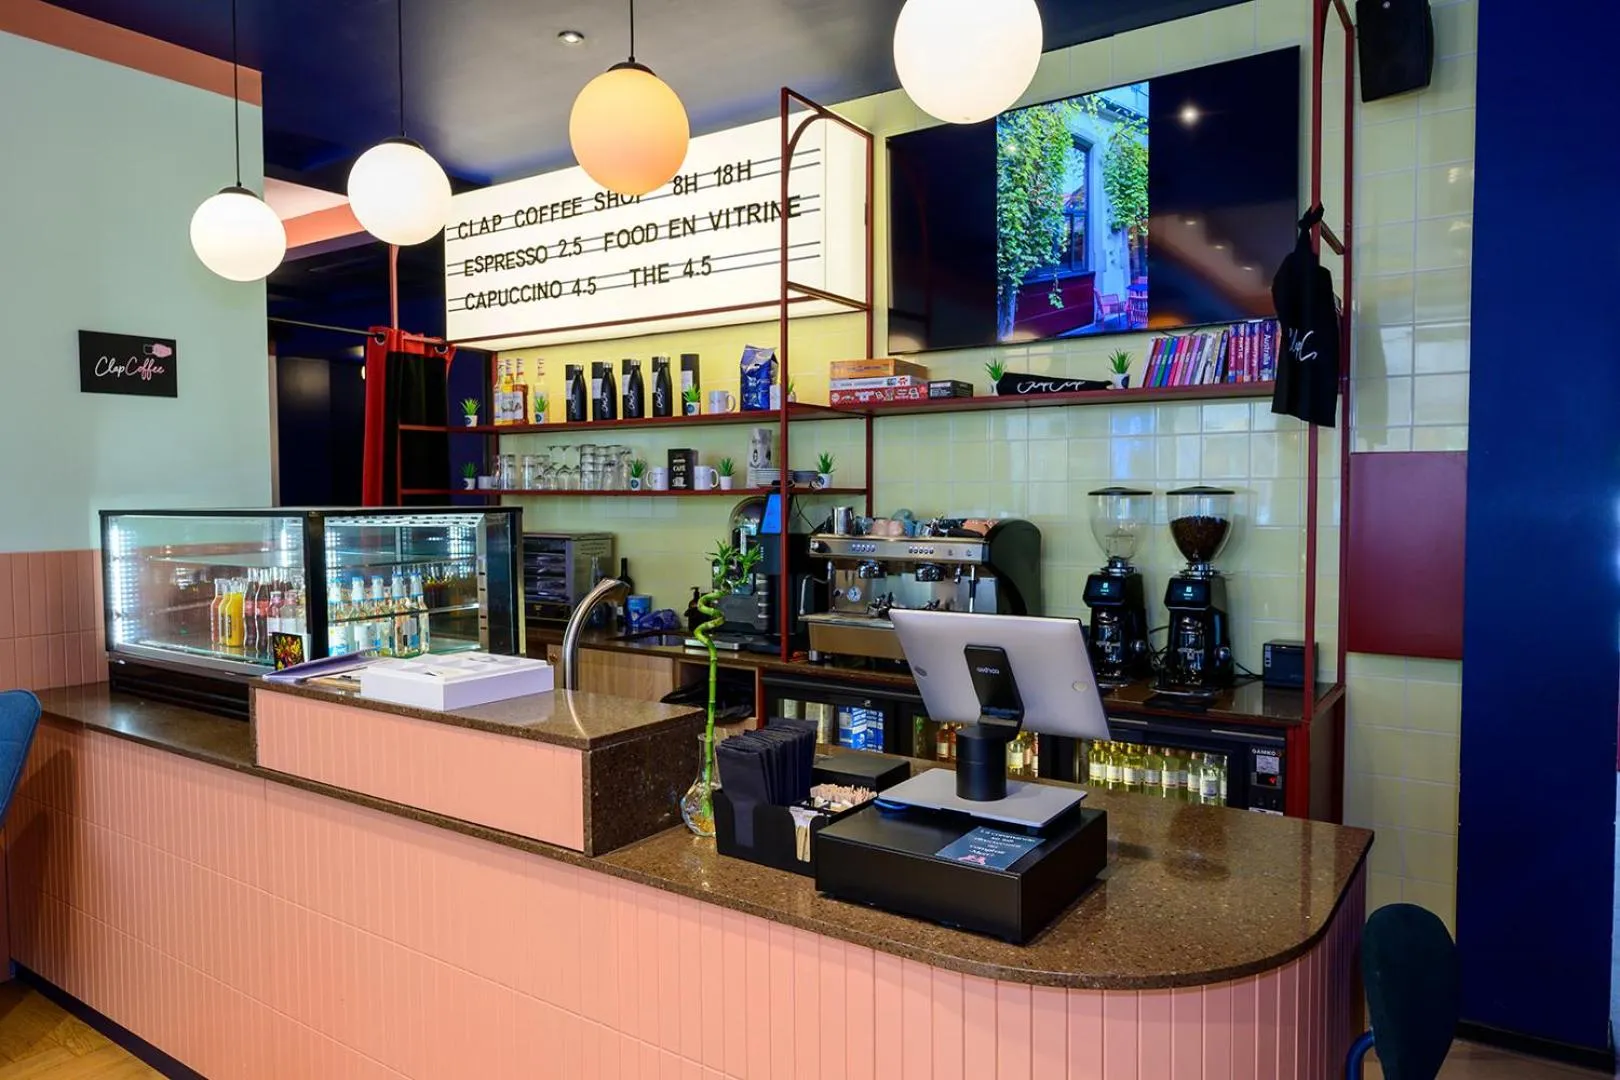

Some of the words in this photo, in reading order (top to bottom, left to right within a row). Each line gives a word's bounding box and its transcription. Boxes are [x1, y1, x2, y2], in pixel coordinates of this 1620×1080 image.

[457, 214, 502, 240] CLAP
[513, 196, 583, 228] COFFEE
[672, 172, 698, 196] 8H
[713, 159, 752, 187] 18H
[464, 245, 548, 277] ESPRESSO
[558, 236, 583, 258] 2.5
[603, 222, 658, 252] FOOD
[668, 214, 696, 240] EN
[708, 194, 801, 231] VITRINE
[464, 280, 563, 310] CAPUCCINO
[629, 262, 670, 288] THE
[683, 255, 713, 279] 4.5
